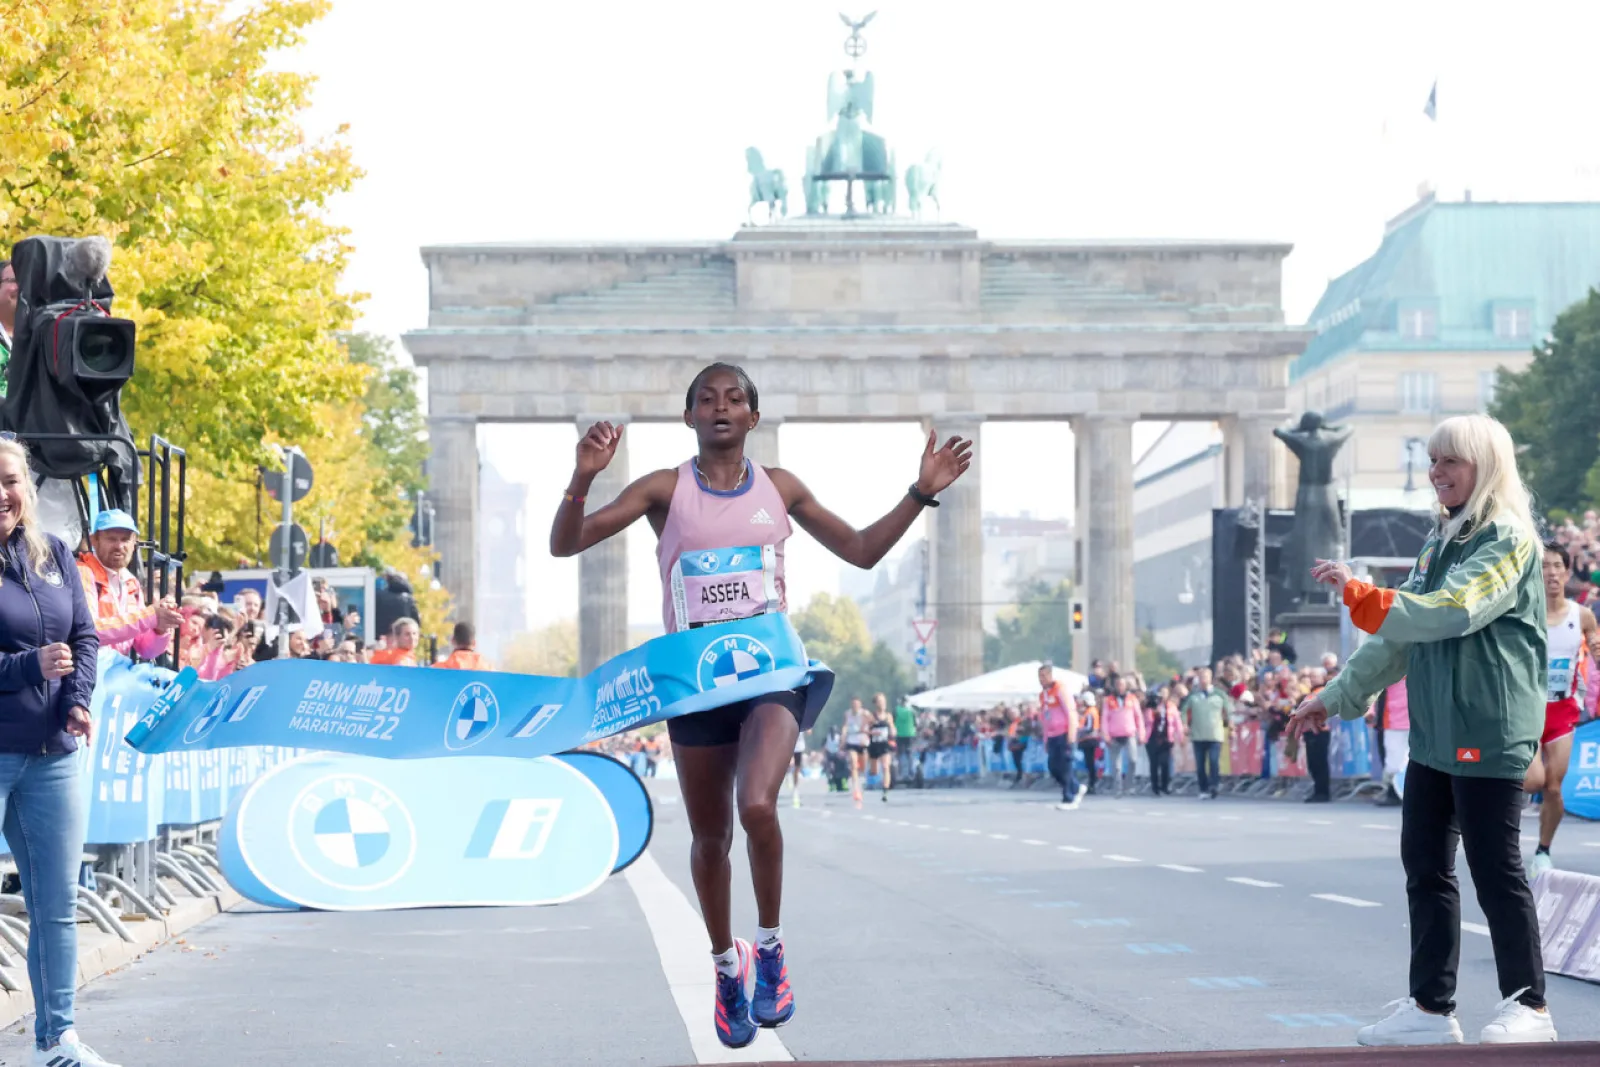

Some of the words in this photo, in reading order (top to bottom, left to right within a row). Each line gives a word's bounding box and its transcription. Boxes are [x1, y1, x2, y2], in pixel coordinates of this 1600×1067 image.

[702, 581, 750, 604] ASSEFA
[704, 638, 762, 665] BMW
[631, 665, 655, 697] 20
[304, 679, 357, 703] BMW
[378, 687, 410, 714] 20
[288, 715, 367, 737] MARATHON
[296, 700, 347, 719] BERLIN
[365, 715, 400, 740] 22
